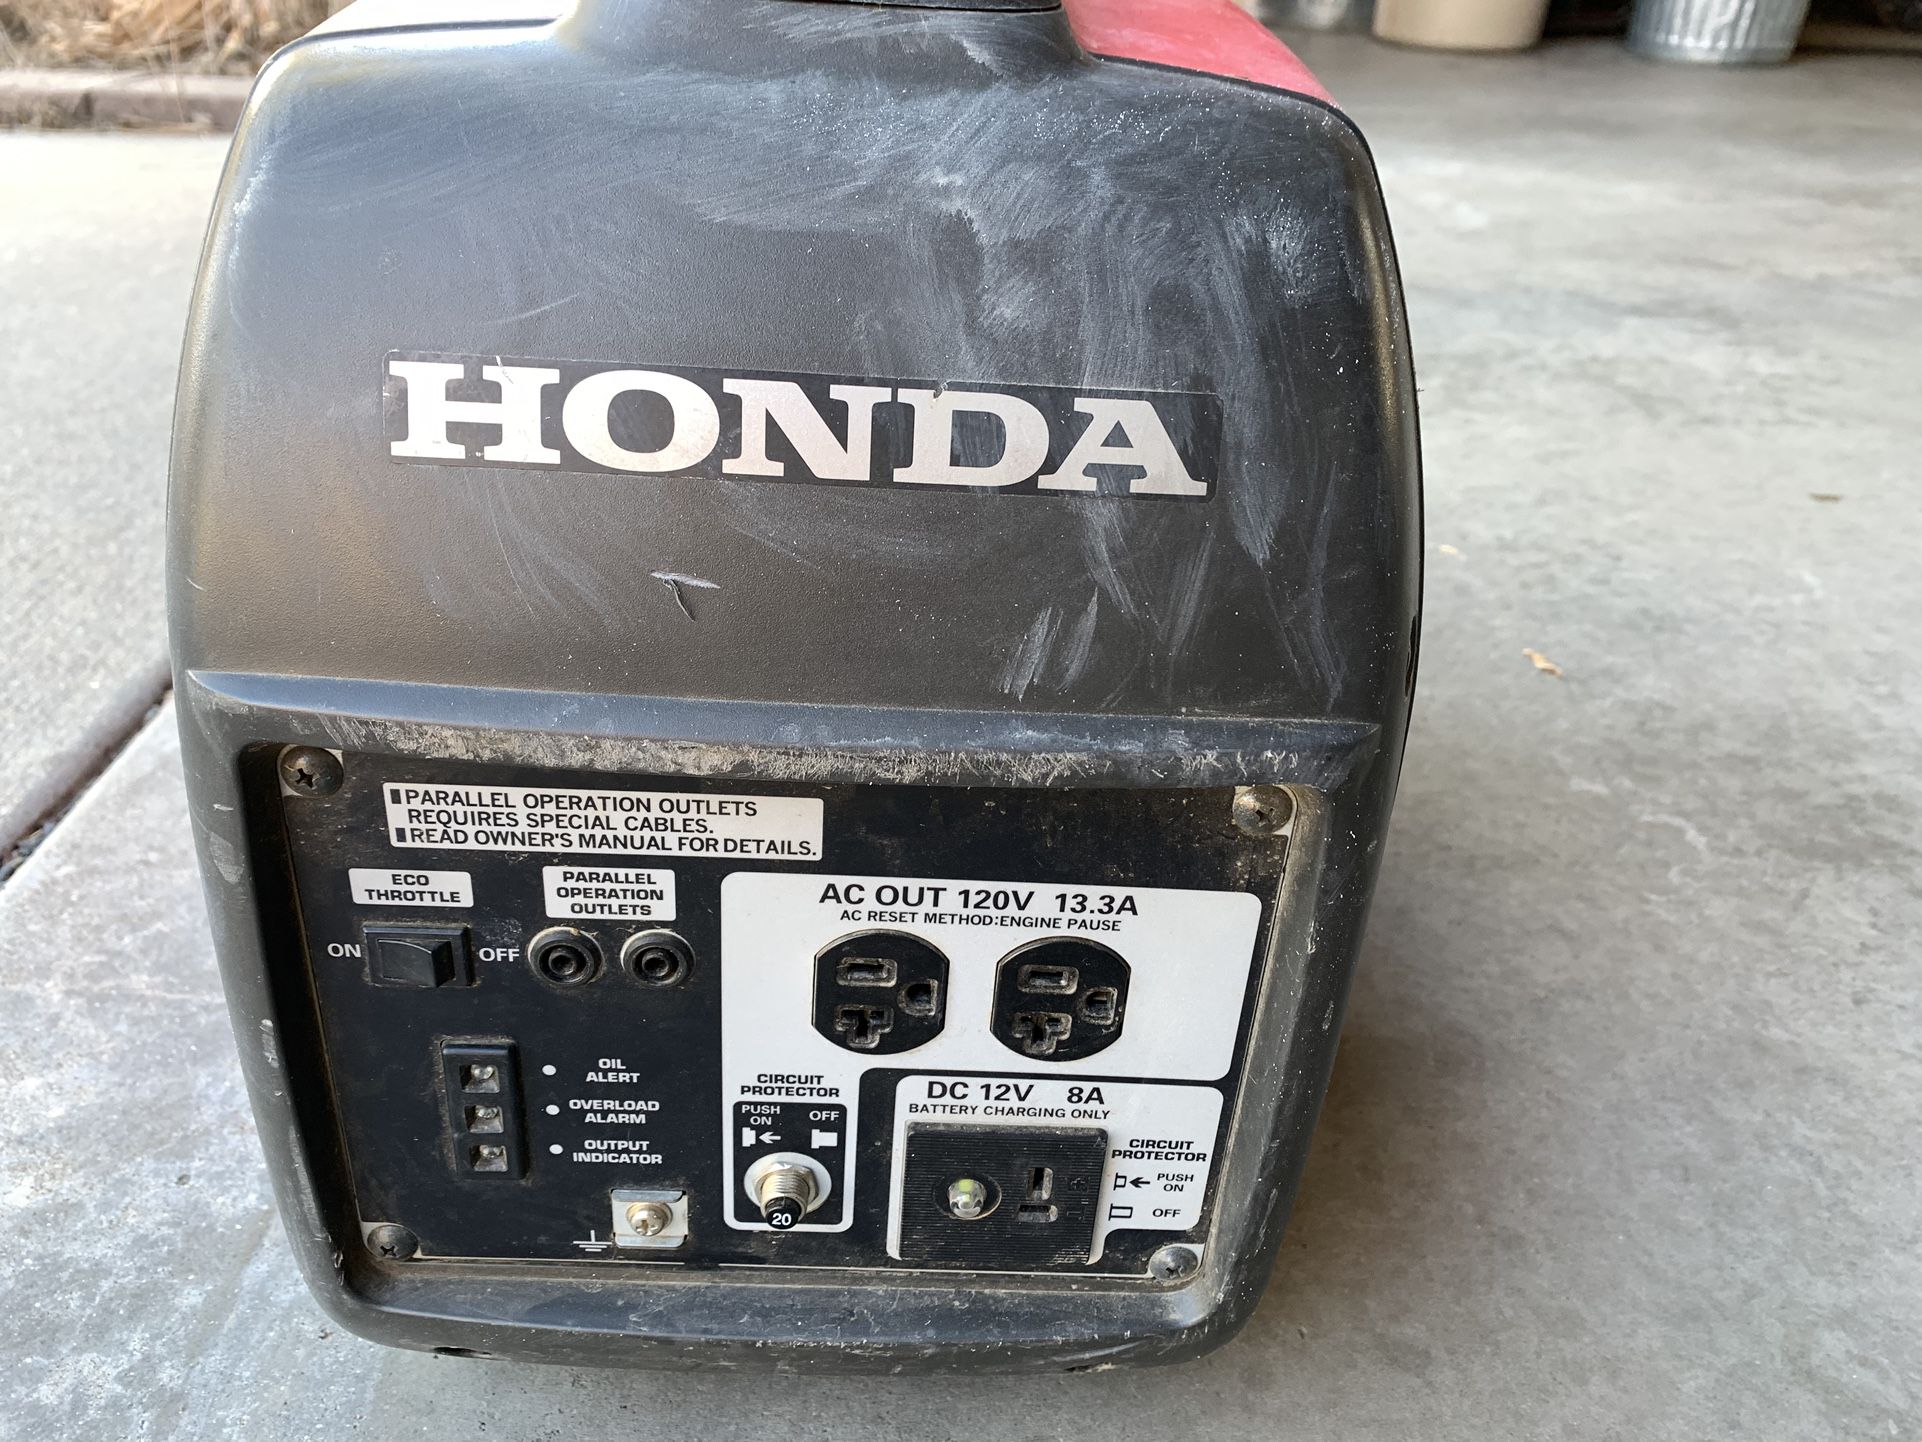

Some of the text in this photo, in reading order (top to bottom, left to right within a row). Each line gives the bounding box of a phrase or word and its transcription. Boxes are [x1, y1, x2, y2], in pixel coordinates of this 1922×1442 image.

[390, 360, 1208, 496] HONDA
[406, 789, 757, 817] PARALLEL OPERATION OUTLETS
[408, 809, 713, 834] REQUIRES SPECIAL CABLES.
[411, 828, 816, 856] READ OWNER'S MANUAL FOR DETAILS.
[392, 873, 429, 886] ECO
[563, 871, 656, 885] PARALLEL
[365, 888, 461, 903] THROTTLE
[556, 886, 663, 901] OPERATION
[819, 883, 1139, 917] AC OUT 120V 13.3A
[570, 902, 652, 916] OUTLETS
[840, 910, 862, 922] AC
[868, 911, 918, 923] RESET
[1067, 919, 1121, 932] PAUSE
[326, 942, 361, 958] ON
[479, 947, 520, 962] OFF
[598, 1059, 626, 1069] OIL
[586, 1072, 640, 1083] ALERT
[757, 1074, 824, 1084] CIRCUIT
[740, 1086, 839, 1097] PROTECTOR
[927, 1081, 1105, 1104] DC 12V 8A
[569, 1100, 660, 1111] OVERLOAD
[742, 1105, 780, 1114] PUSH
[909, 1104, 1110, 1119] BATTERY CHARGING ONLY
[585, 1114, 646, 1124] ALARM
[750, 1116, 771, 1125] ON
[809, 1111, 839, 1121] OFF
[584, 1140, 649, 1151] OUTPUT
[1129, 1139, 1194, 1150] CIRCUIT
[573, 1153, 662, 1164] INDICATOR
[1112, 1150, 1206, 1162] PROTECTOR
[1157, 1173, 1194, 1182] PUSH
[1163, 1183, 1184, 1192] ON
[1152, 1208, 1181, 1217] OFF
[772, 1213, 791, 1226] 20
